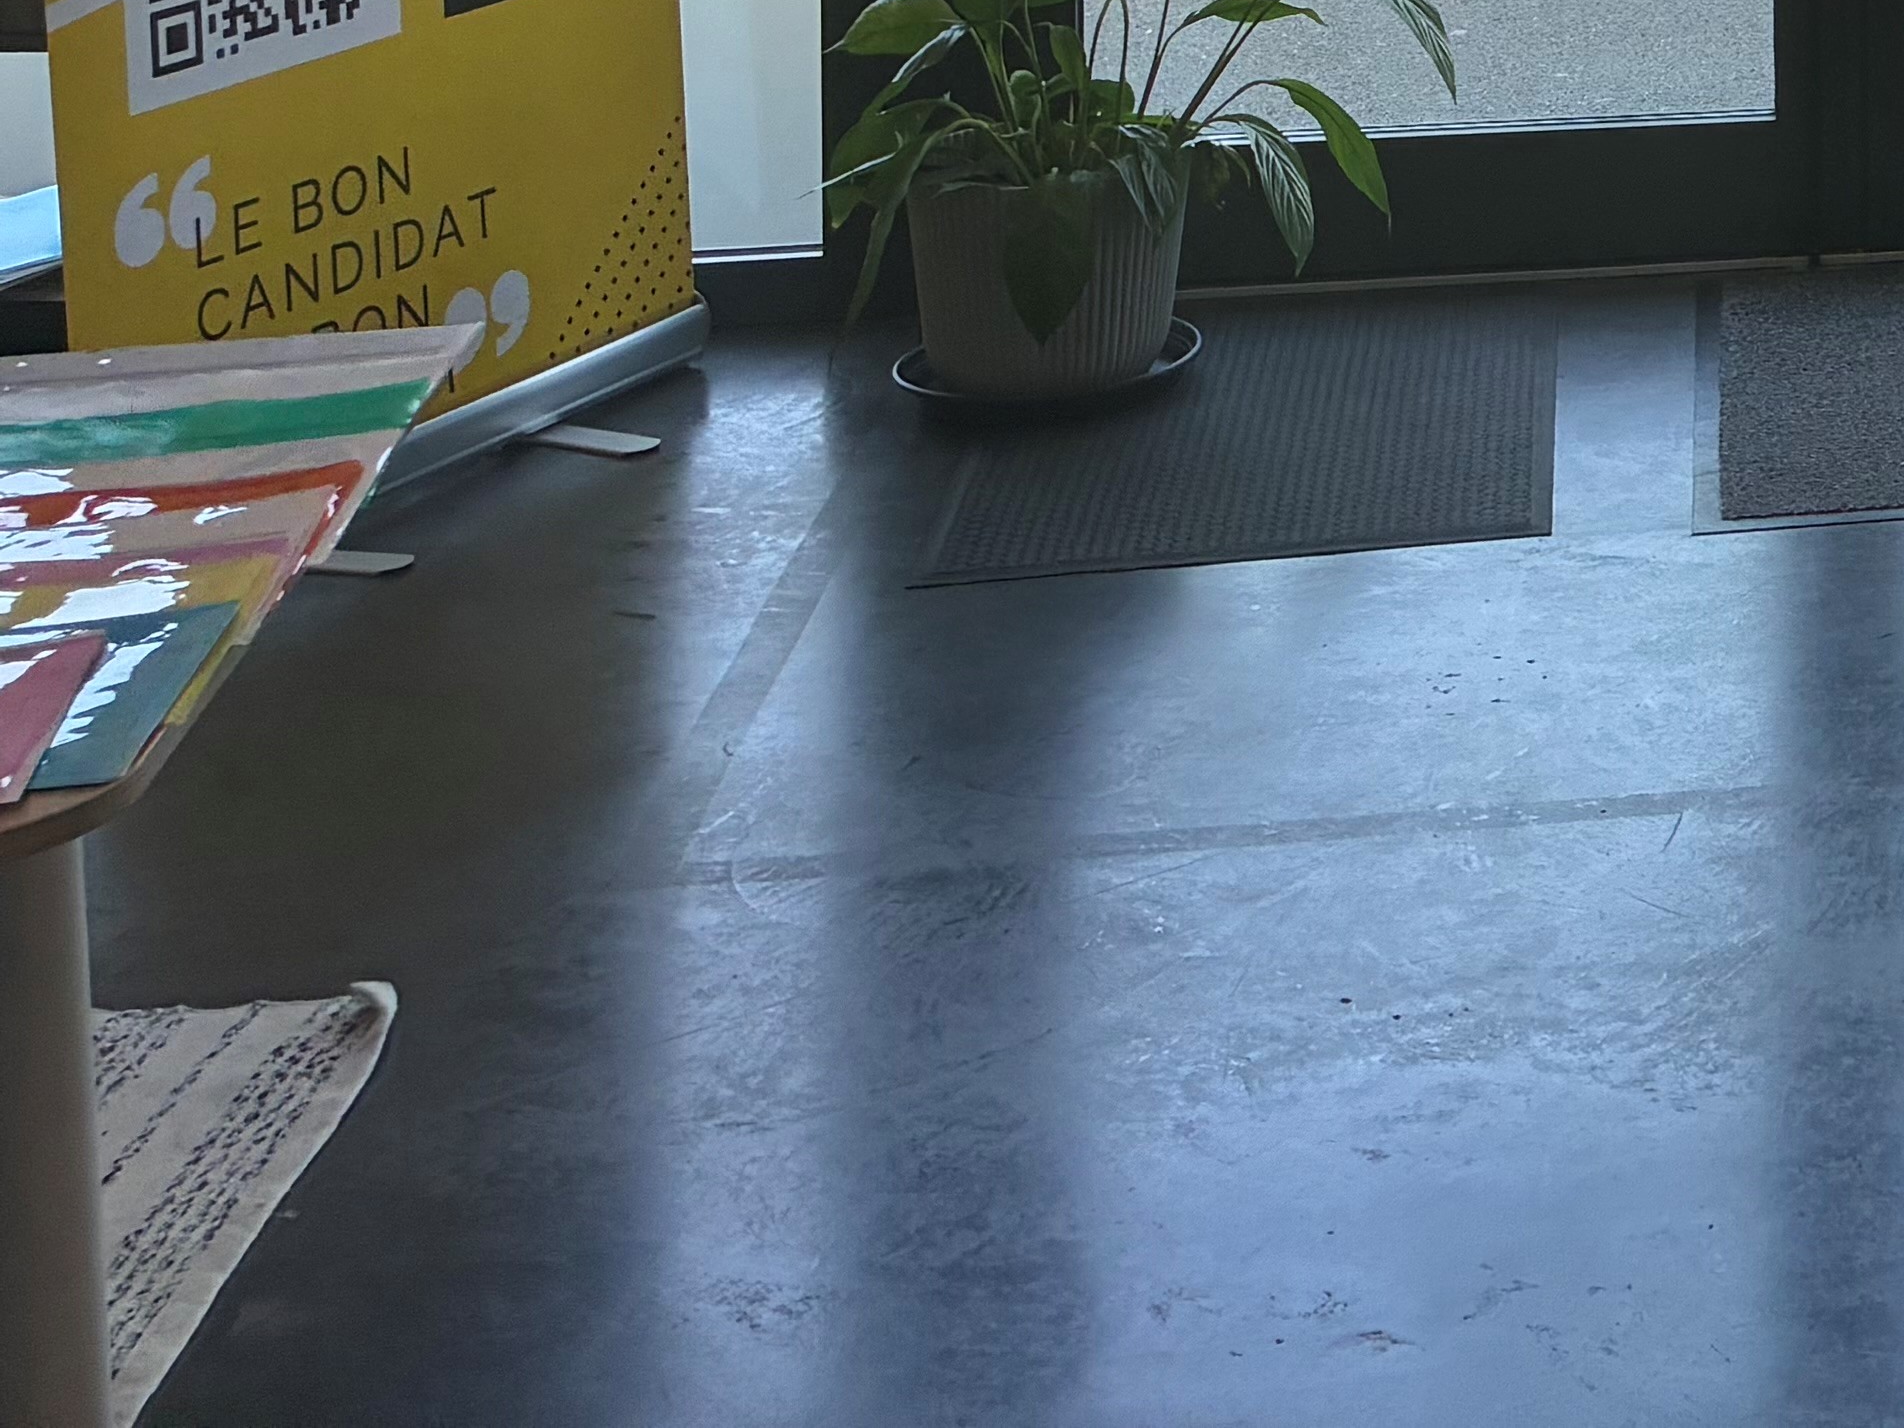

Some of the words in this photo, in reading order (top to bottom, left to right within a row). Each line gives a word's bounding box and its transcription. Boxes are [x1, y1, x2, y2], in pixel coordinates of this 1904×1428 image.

[195, 196, 262, 269] LE
[291, 146, 410, 234] BON
[197, 186, 497, 342] CANDIDAT
